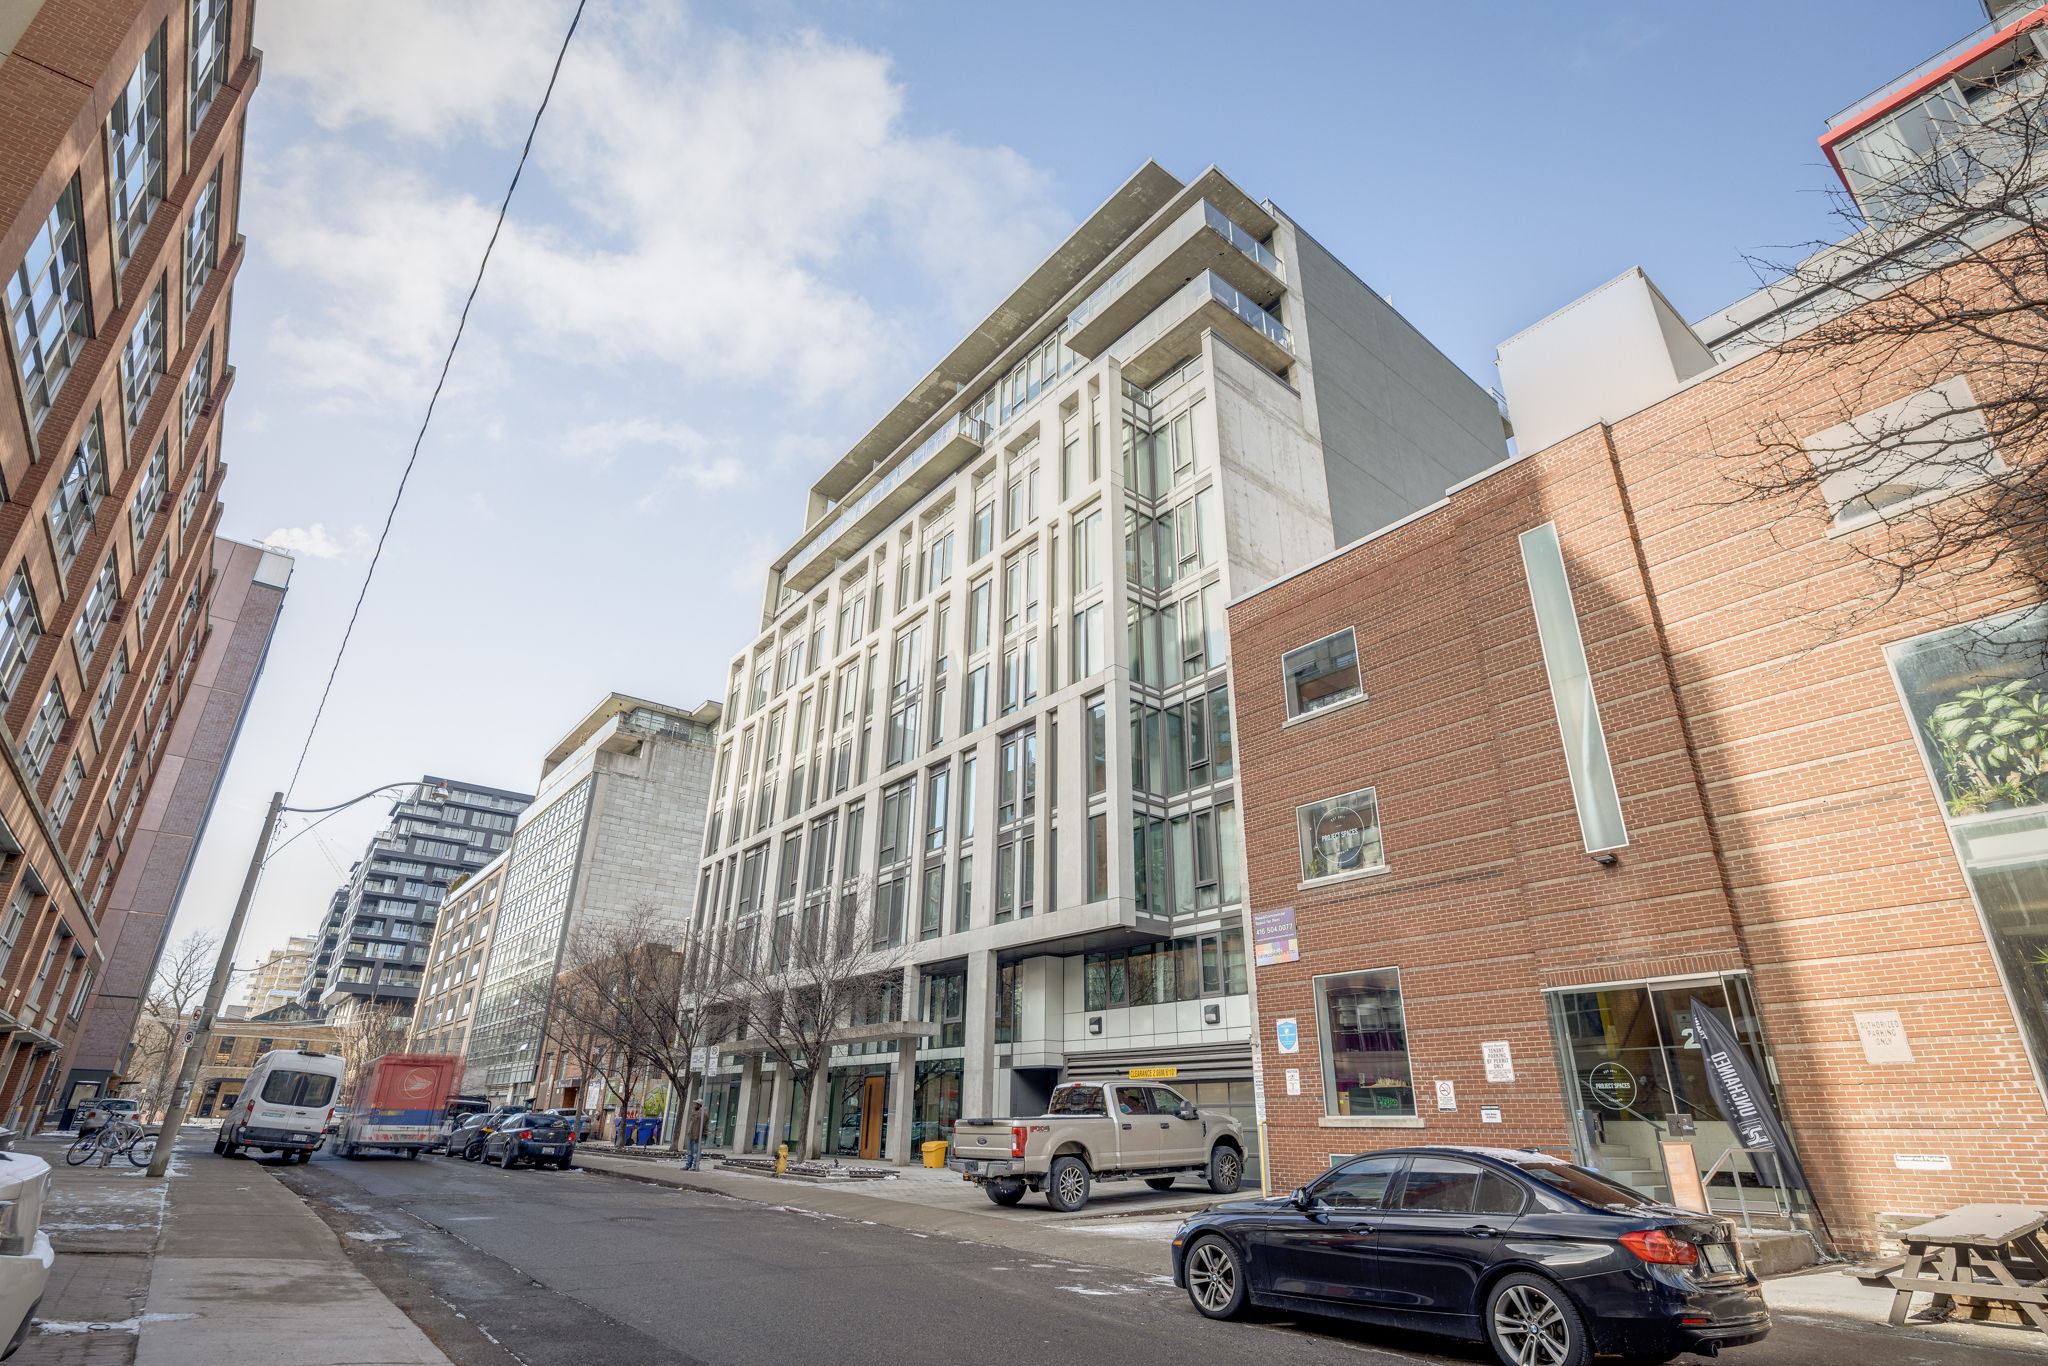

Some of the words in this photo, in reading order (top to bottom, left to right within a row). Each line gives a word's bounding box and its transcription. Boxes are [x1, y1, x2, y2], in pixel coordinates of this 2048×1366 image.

[1321, 831, 1341, 842] PROJECT
[1341, 828, 1359, 838] SPACES
[1859, 1020, 1899, 1030] AUTHORIZED
[1866, 1029, 1897, 1038] PARKING
[1876, 1037, 1893, 1047] ONLY
[1130, 1069, 1152, 1079] CLEARANCE
